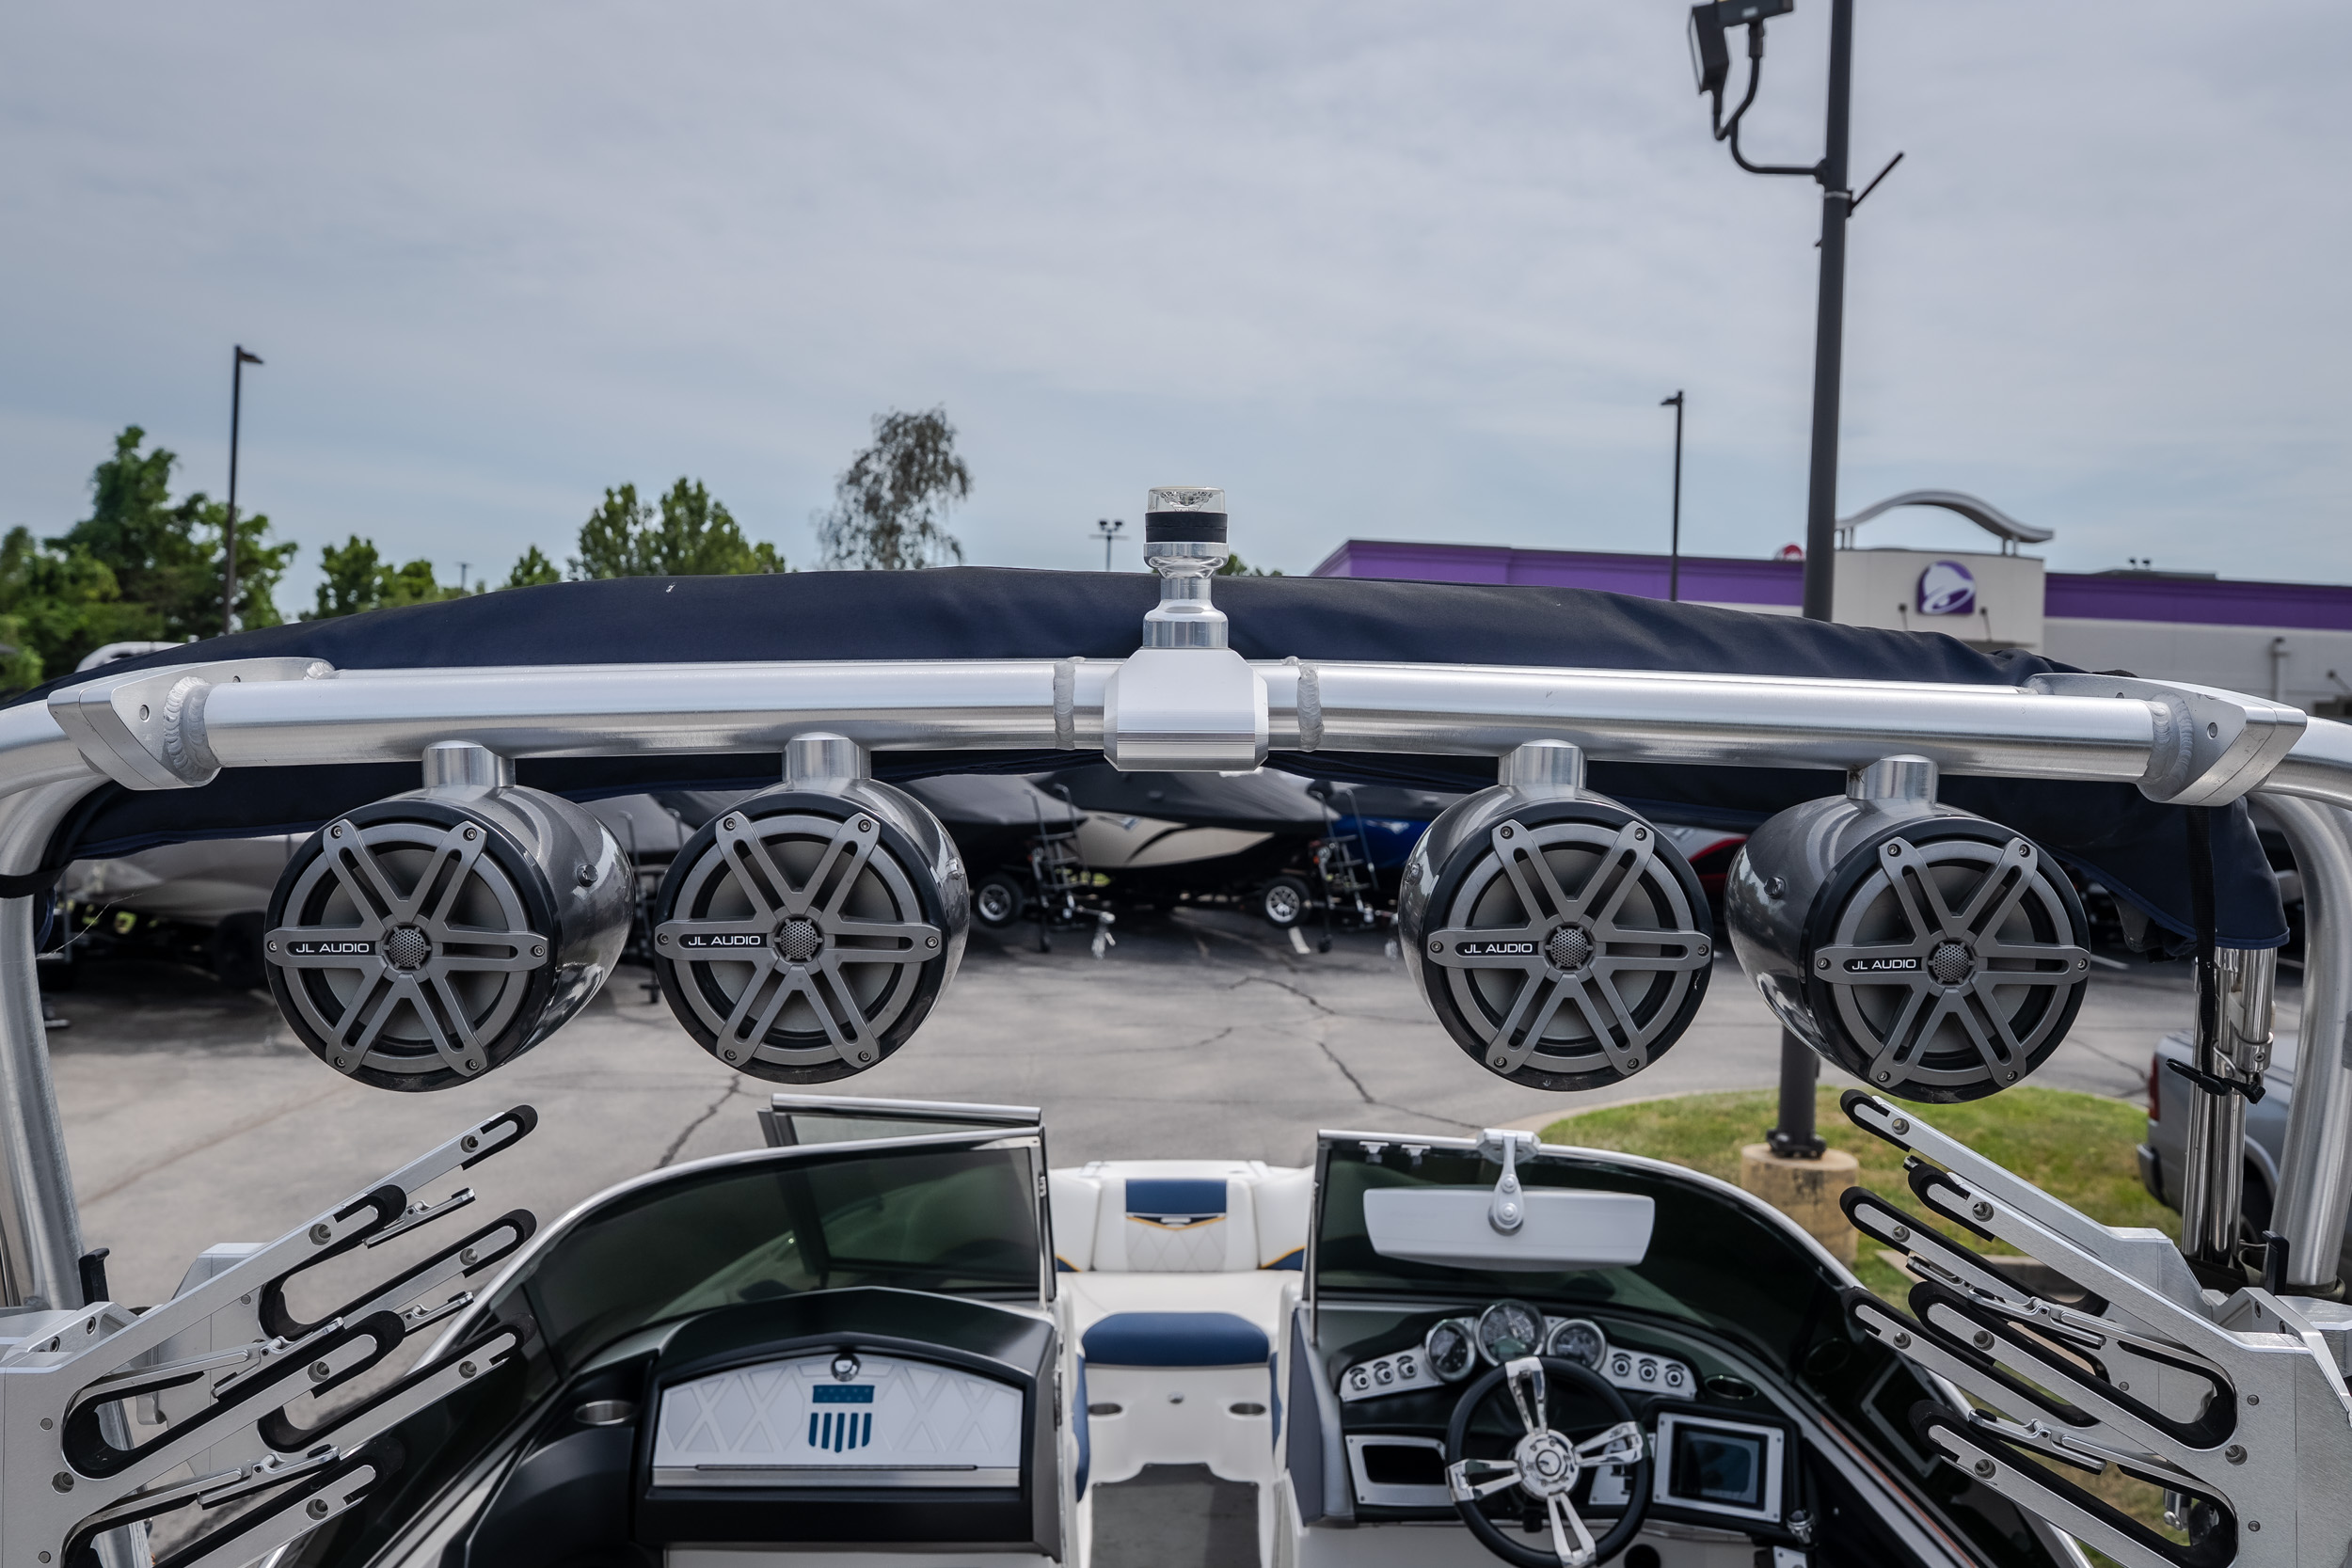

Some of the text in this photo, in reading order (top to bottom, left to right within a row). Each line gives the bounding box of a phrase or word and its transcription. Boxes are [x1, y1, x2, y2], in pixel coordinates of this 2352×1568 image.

[688, 935, 761, 946] JL AUDIO
[295, 942, 370, 953] JL AUDIO
[1464, 942, 1533, 954] JL AUDIO
[1851, 958, 1916, 970] JL AUDIO
